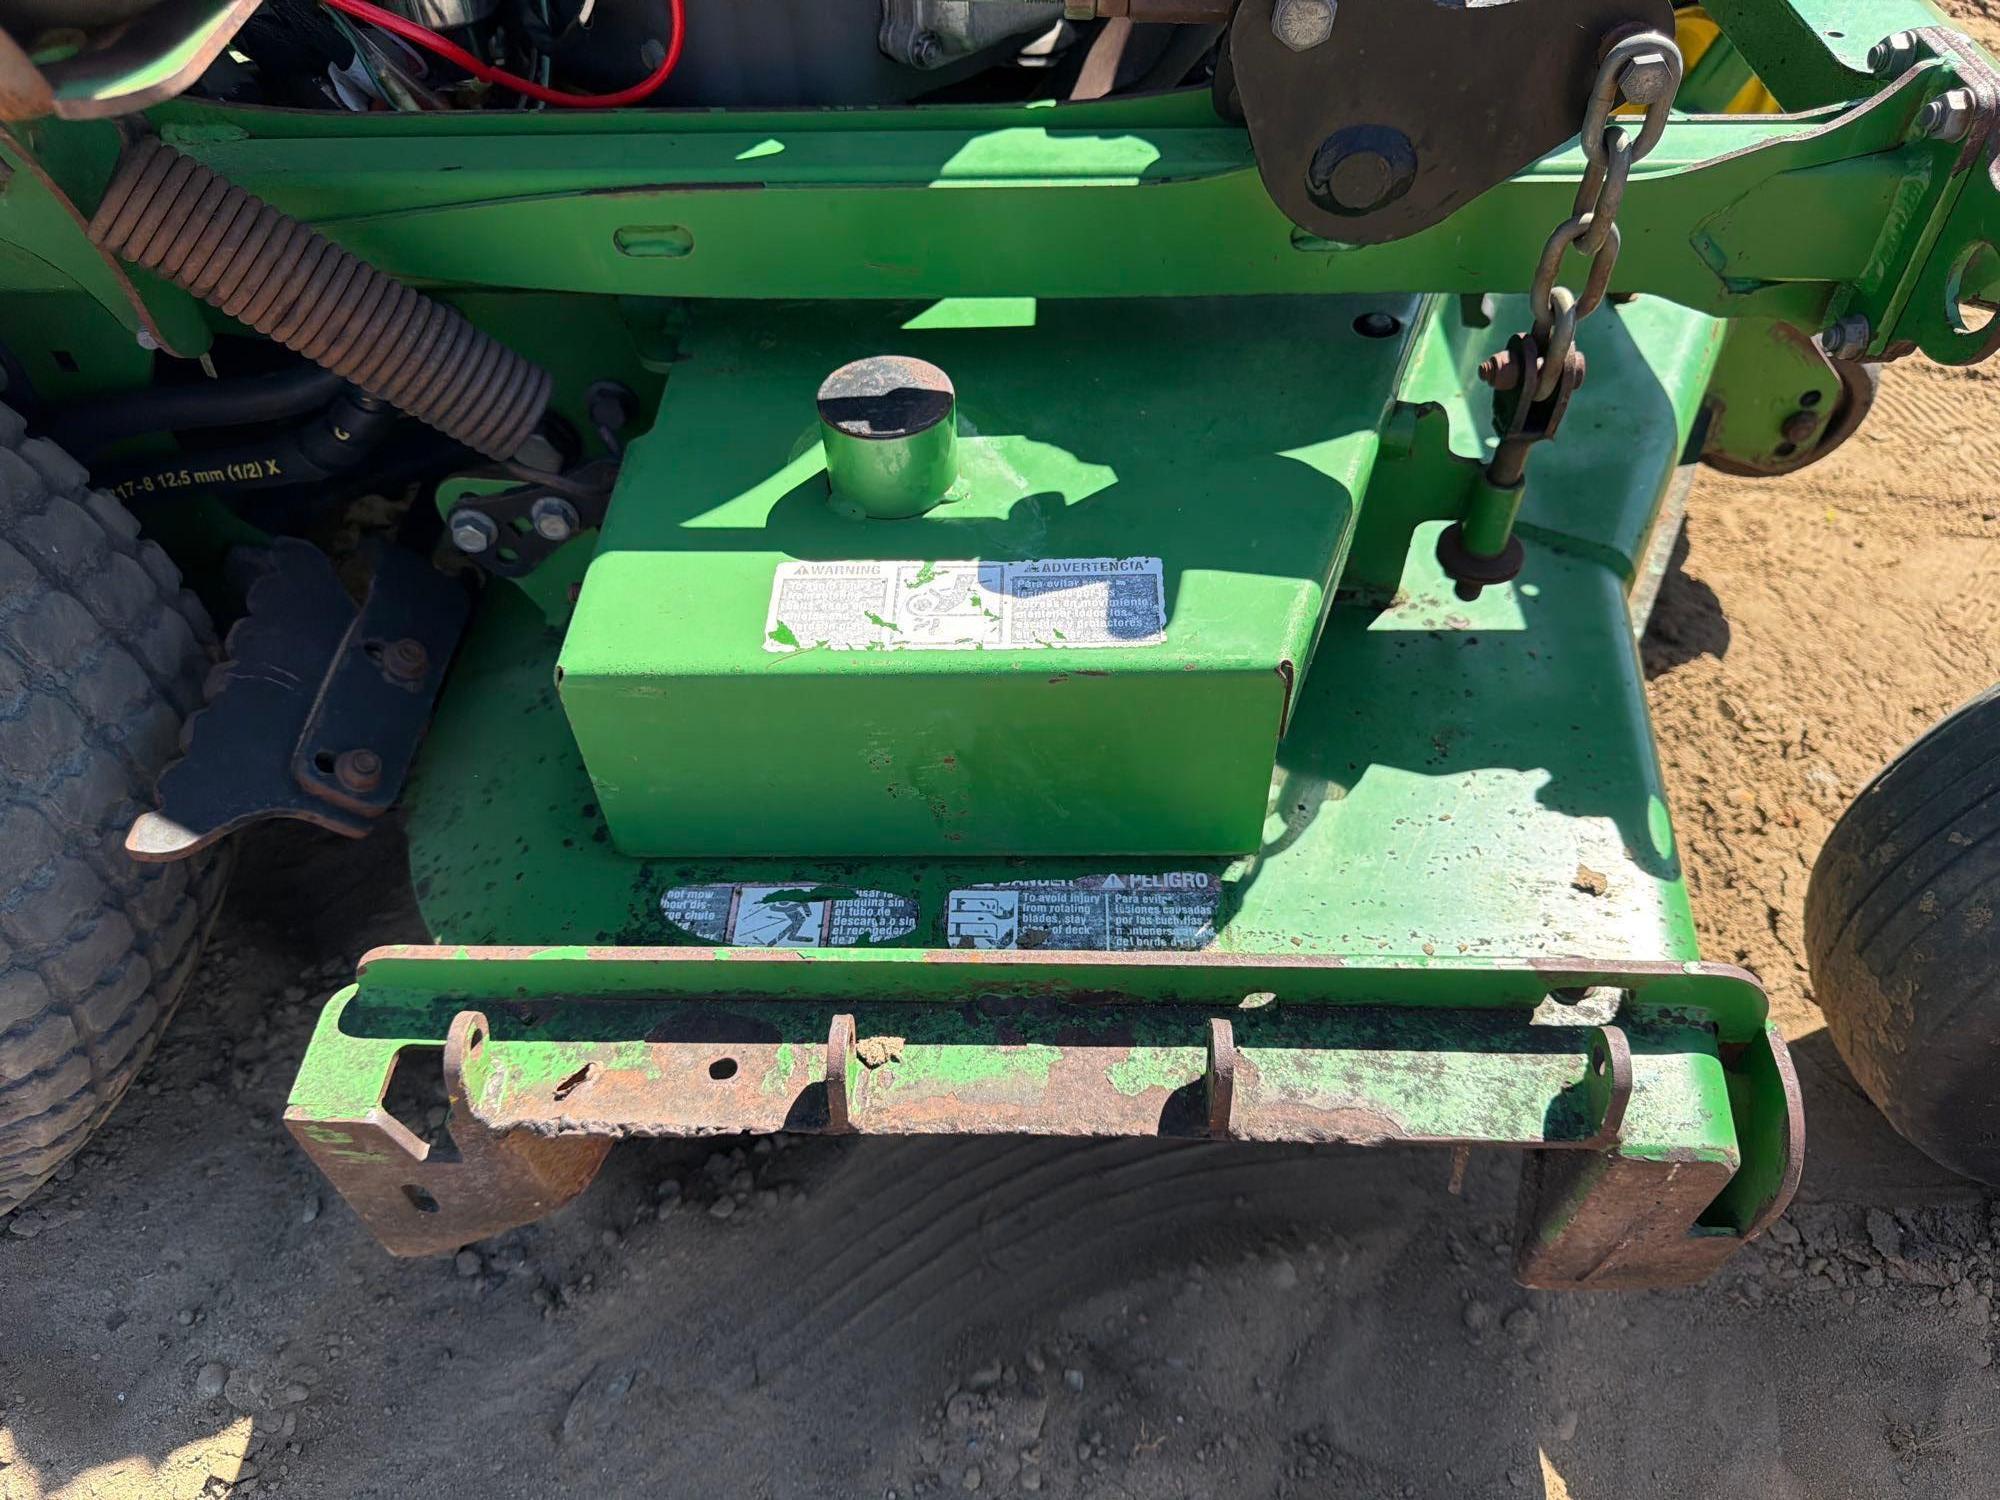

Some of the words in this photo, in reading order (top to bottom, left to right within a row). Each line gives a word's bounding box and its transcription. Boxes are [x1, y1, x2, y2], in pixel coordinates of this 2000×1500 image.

[194, 467, 225, 484] mm
[227, 461, 263, 482] (1/2)
[265, 458, 282, 476] X
[811, 565, 881, 576] WARNING
[1042, 560, 1145, 574] ADVERTENCIA
[1017, 580, 1043, 589] Para
[1076, 617, 1143, 629] protectores
[1129, 872, 1209, 889] PELIGRO
[667, 890, 685, 899] not
[687, 890, 714, 899] mow
[1022, 892, 1036, 901] To
[1038, 891, 1067, 902] avoid
[1069, 890, 1100, 905] injury
[1114, 893, 1139, 903] Para
[887, 897, 906, 907] sin
[834, 906, 845, 917] el
[849, 906, 874, 917] tubo
[1022, 903, 1047, 912] from
[1049, 903, 1091, 915] rotating
[685, 910, 716, 921] chute
[1022, 913, 1061, 925] blades,
[1064, 914, 1087, 926] stay
[1114, 914, 1132, 926] por
[1136, 914, 1153, 925] las
[833, 915, 885, 928] descarga
[889, 918, 897, 926] o
[898, 915, 916, 927] sin
[831, 925, 843, 935] el
[1052, 925, 1063, 935] of
